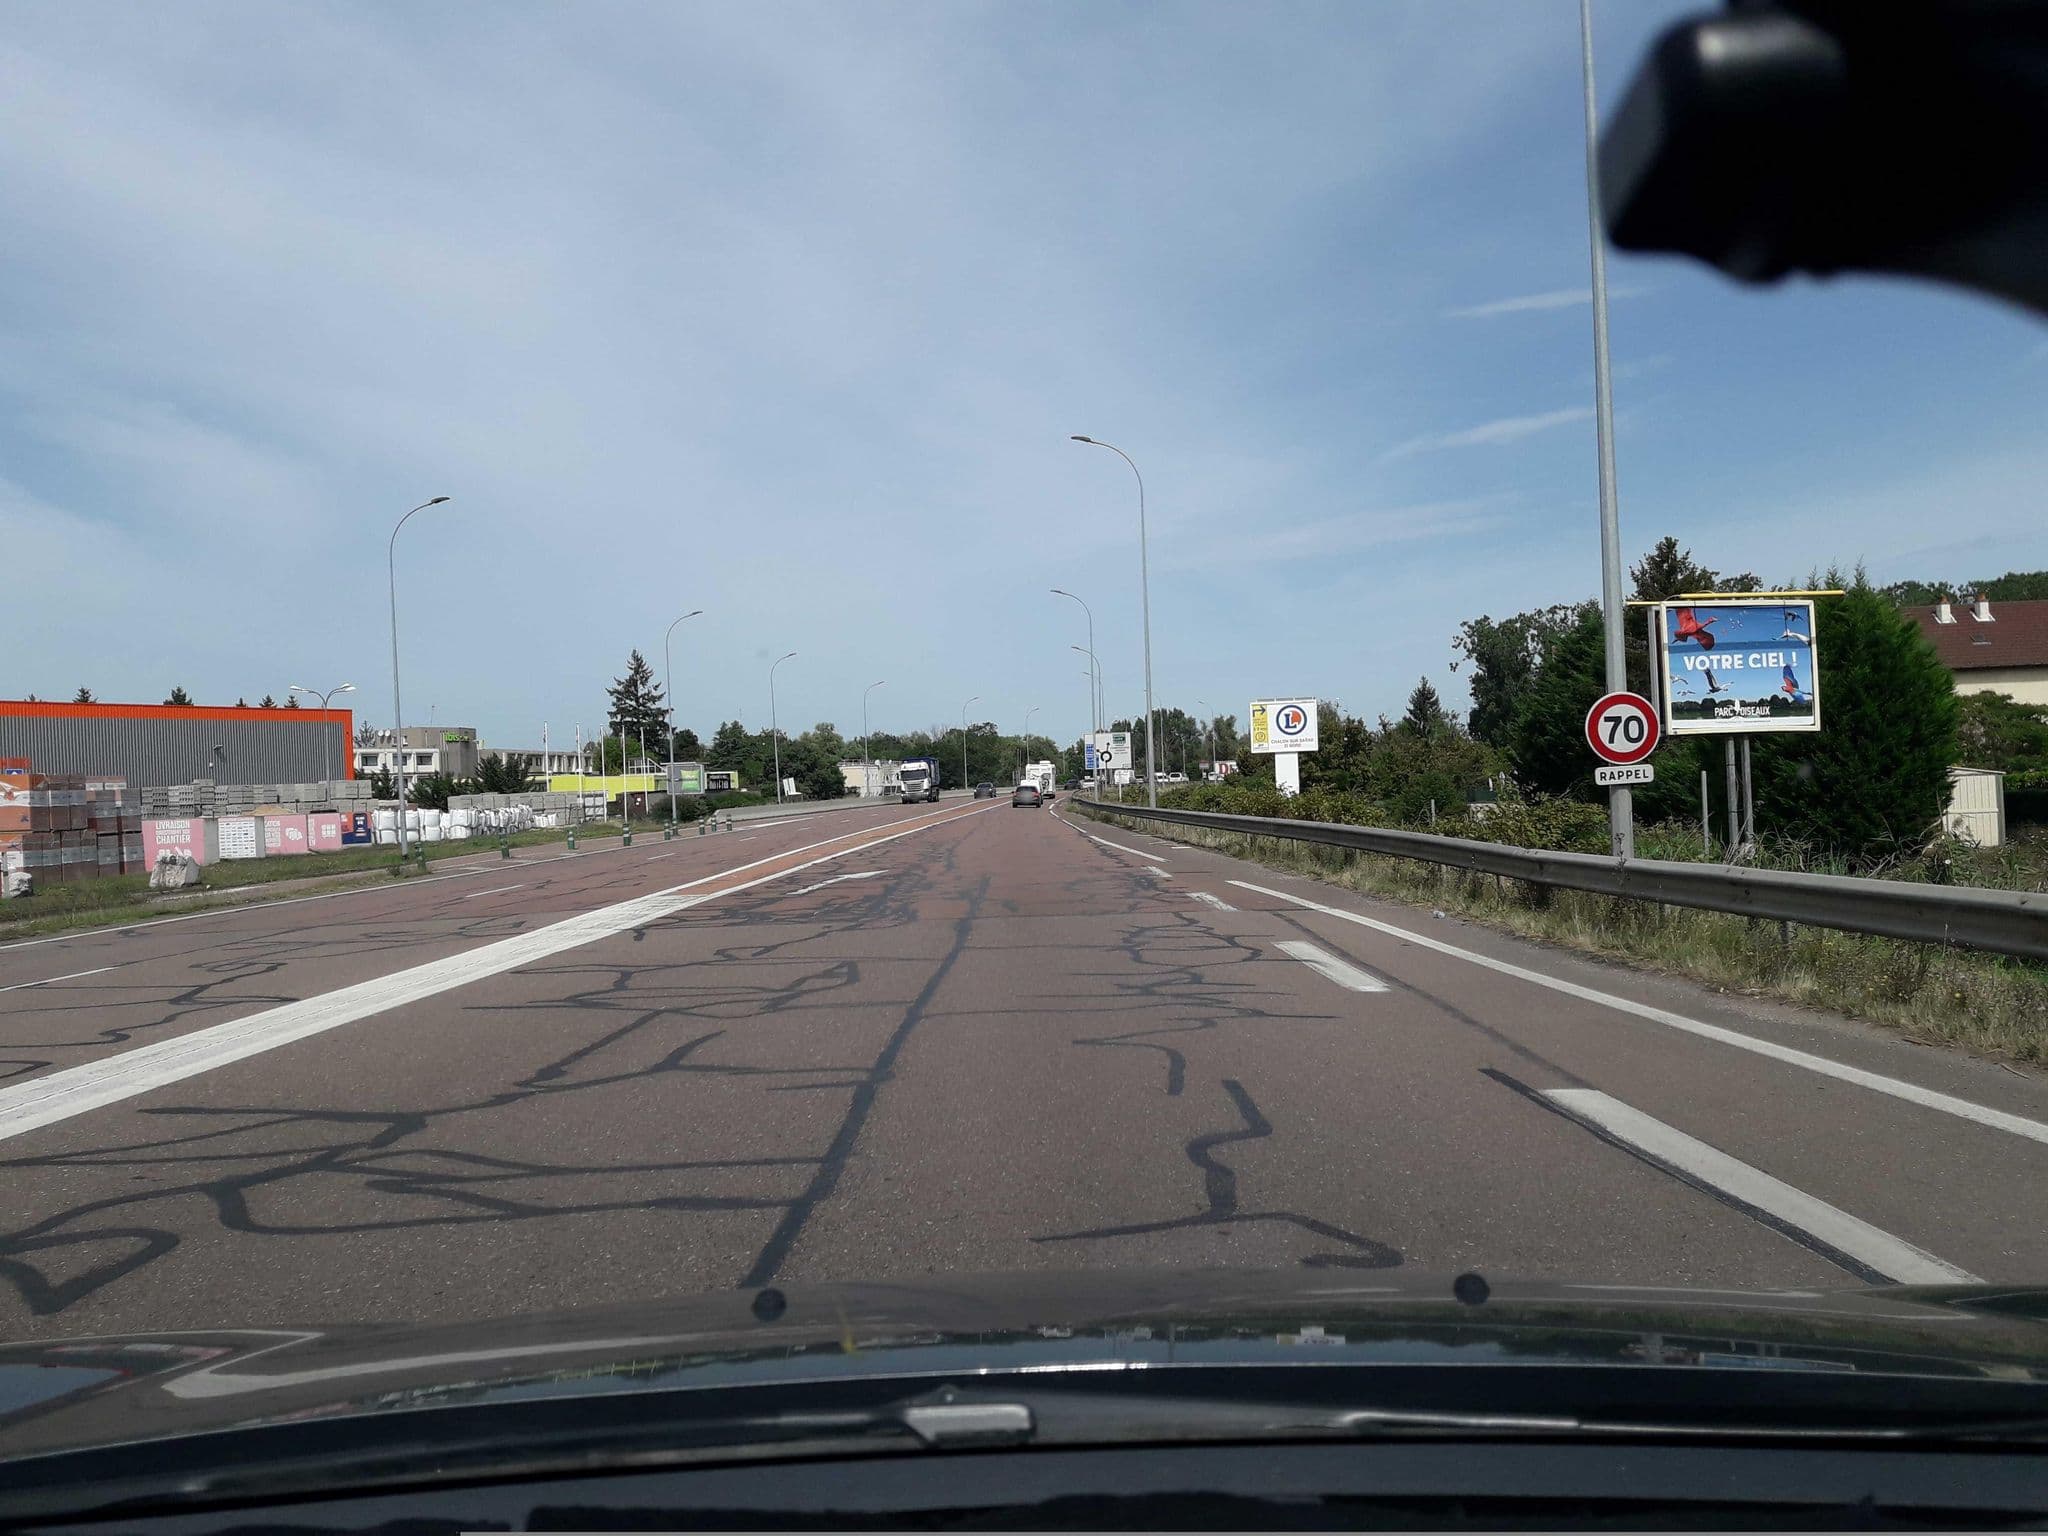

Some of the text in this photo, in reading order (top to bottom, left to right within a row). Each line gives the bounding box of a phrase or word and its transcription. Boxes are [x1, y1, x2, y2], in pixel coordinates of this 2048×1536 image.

[1683, 654, 1744, 671] VOTRE
[1748, 652, 1787, 668] CIEL
[1714, 706, 1770, 717] PARC OISEAUX
[1284, 713, 1297, 729] L
[1604, 715, 1644, 744] 70
[1600, 769, 1649, 781] RAPPEL
[155, 820, 190, 829] LIVRAISON
[156, 835, 191, 844] CHANTIER
